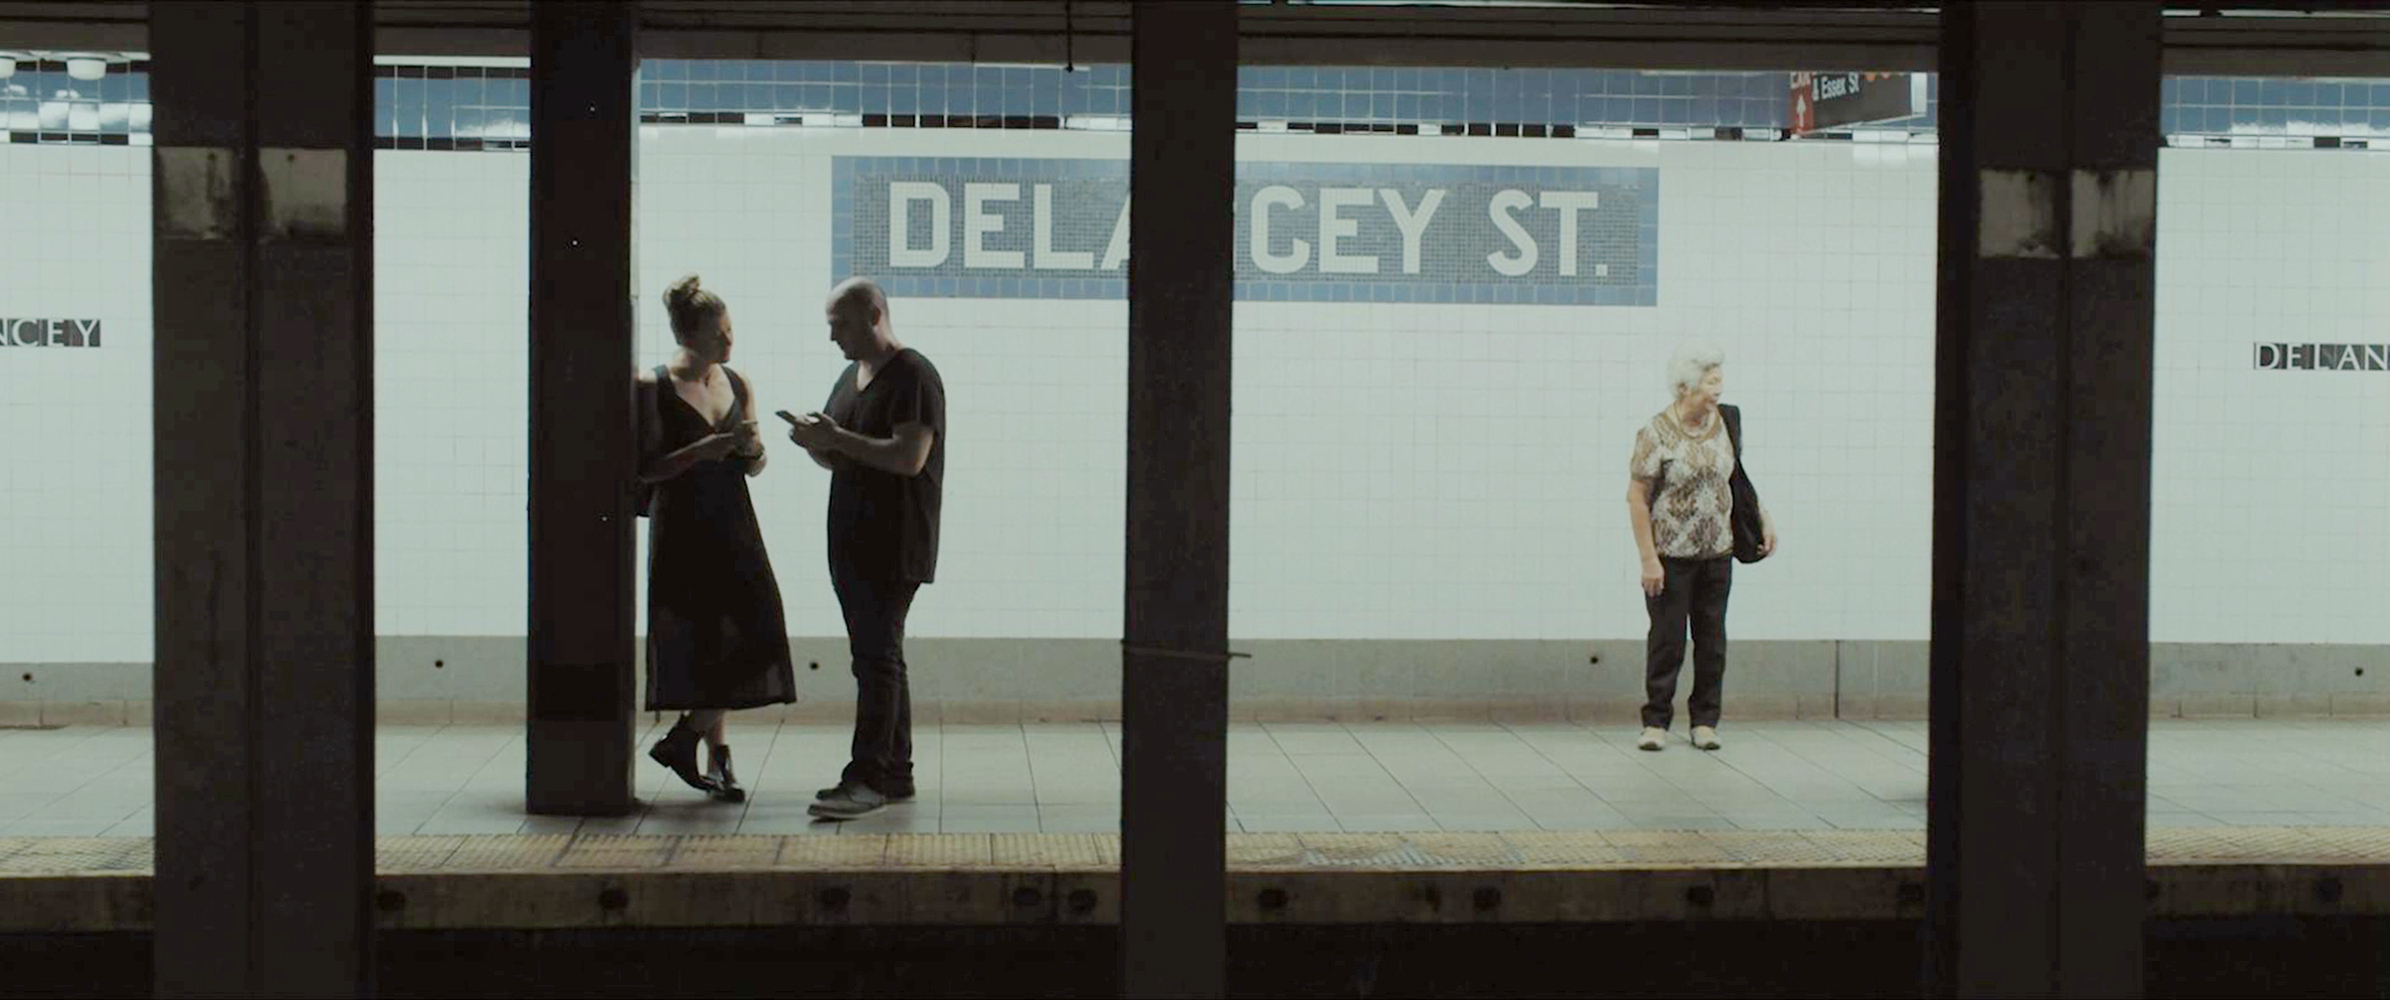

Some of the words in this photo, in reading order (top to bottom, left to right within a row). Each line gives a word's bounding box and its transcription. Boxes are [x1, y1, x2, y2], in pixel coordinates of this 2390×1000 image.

[1821, 76, 1847, 99] Essex
[889, 181, 1446, 275] DELCEY
[1487, 189, 1608, 277] ST.
[2255, 342, 2389, 371] DELAN
